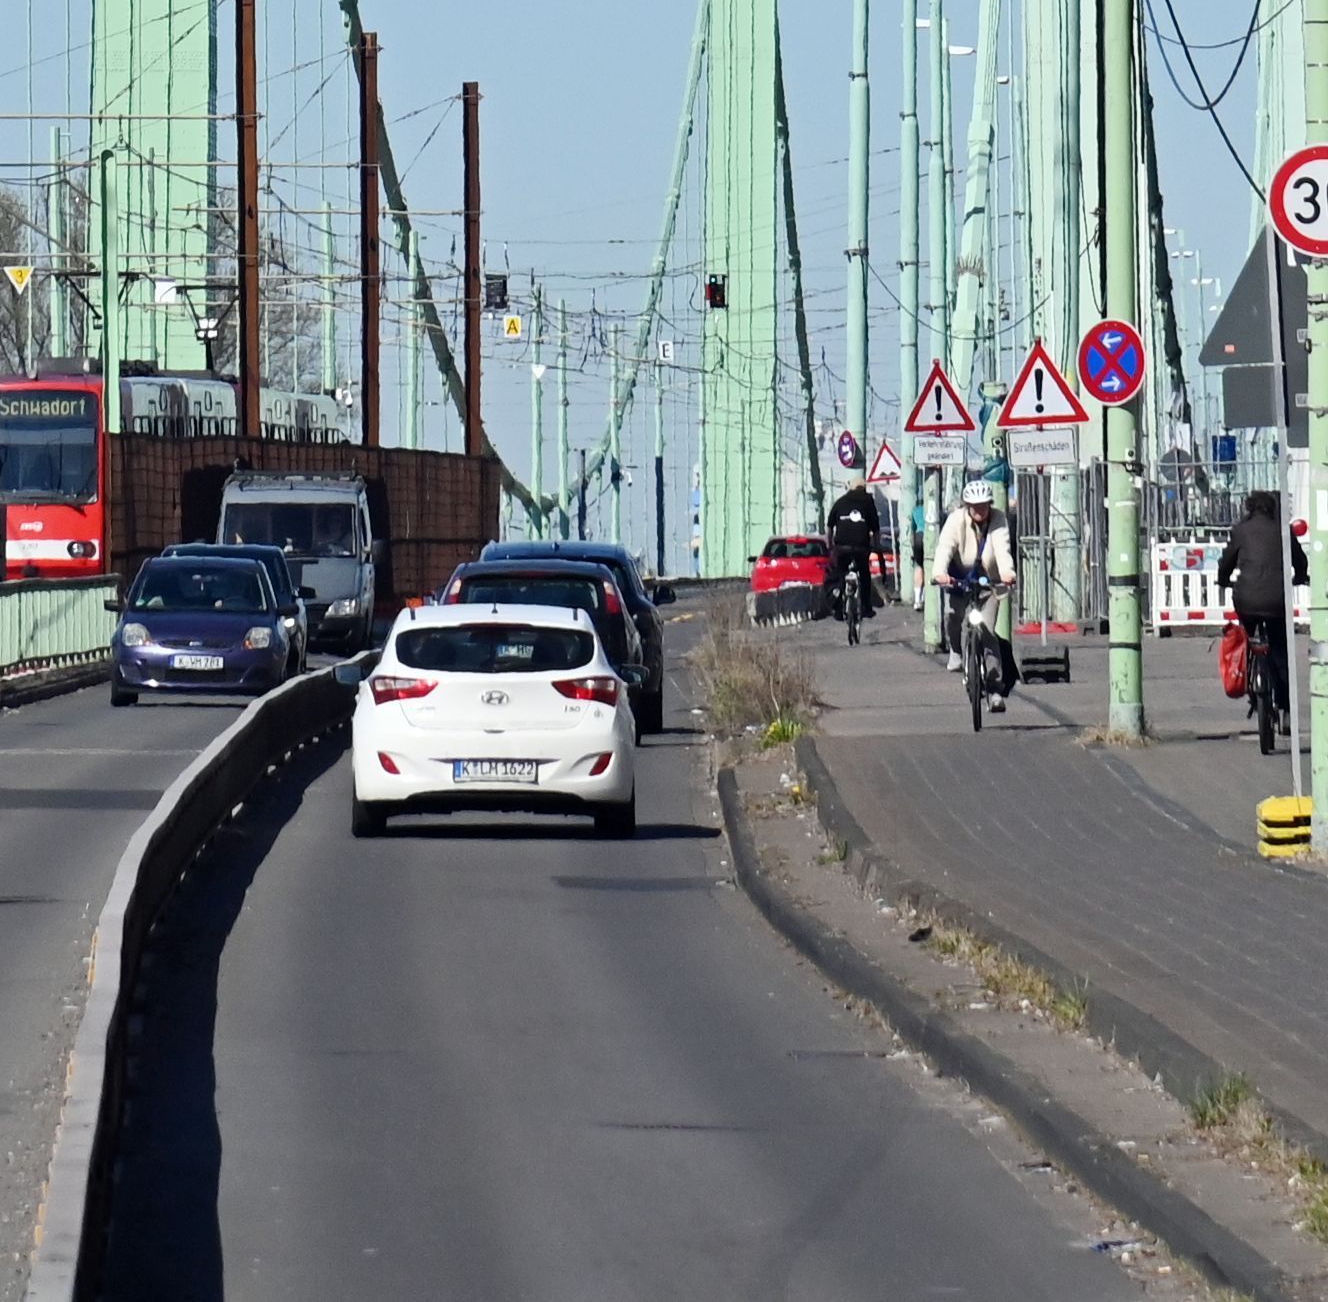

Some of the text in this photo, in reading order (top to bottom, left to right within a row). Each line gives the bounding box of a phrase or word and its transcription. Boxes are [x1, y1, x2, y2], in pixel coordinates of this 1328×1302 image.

[507, 320, 518, 334] A
[662, 343, 671, 358] E
[0, 398, 86, 417] Schwadorf
[462, 761, 471, 775] K
[502, 760, 534, 776] 1622
